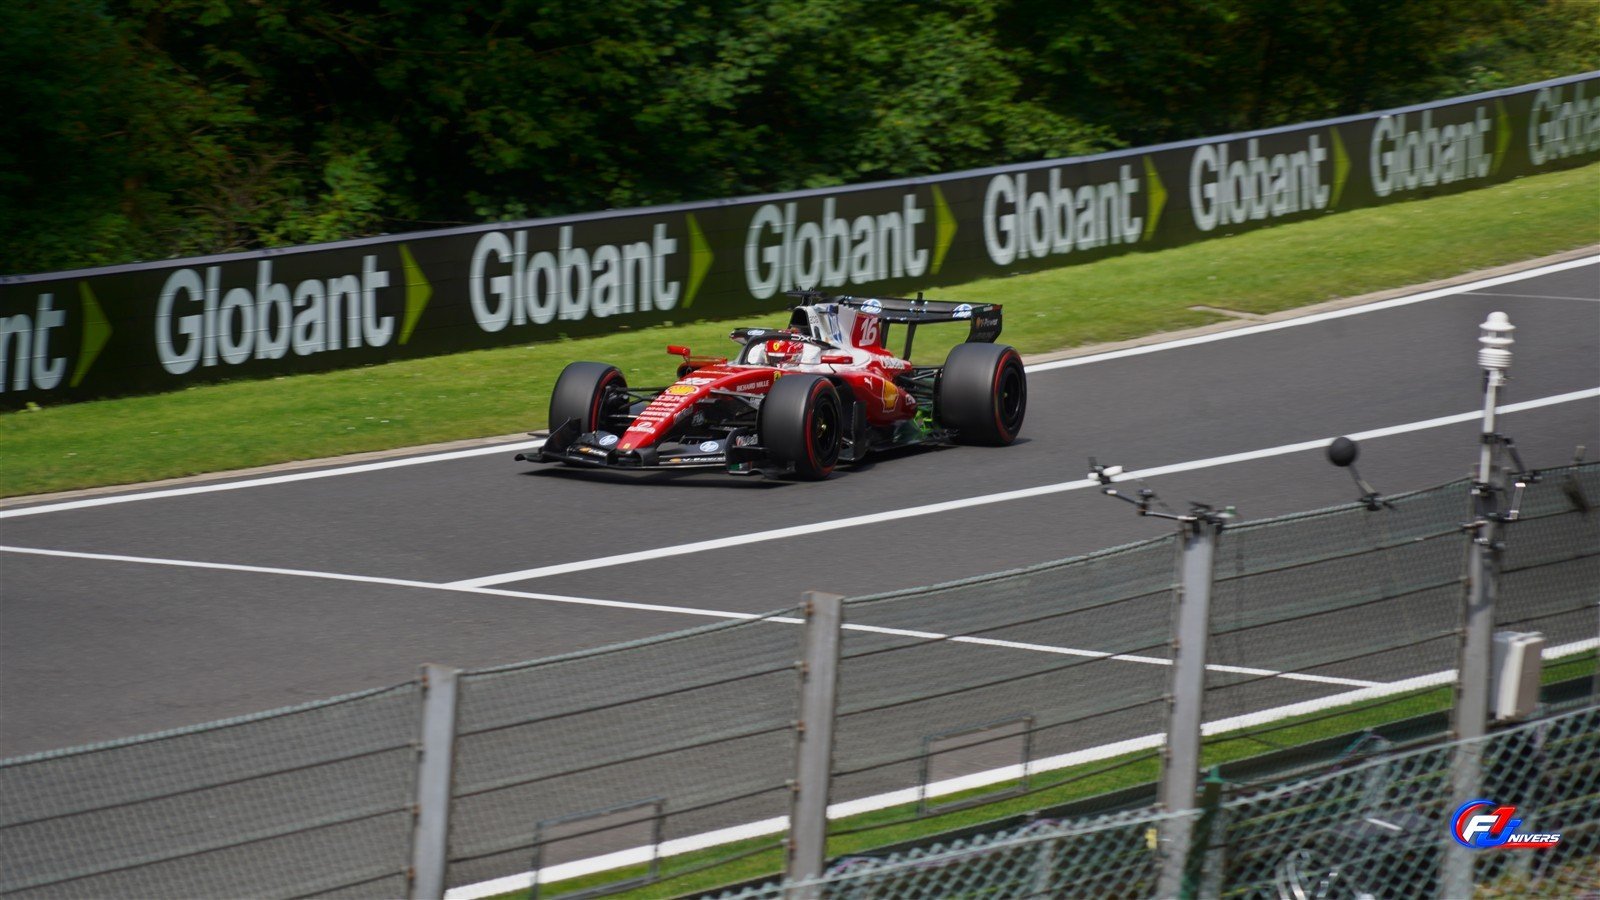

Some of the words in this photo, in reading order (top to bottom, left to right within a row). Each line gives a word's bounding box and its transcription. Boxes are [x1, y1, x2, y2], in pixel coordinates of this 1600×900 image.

[1189, 134, 1331, 231] Globant
[1370, 106, 1492, 197] Globant
[744, 193, 930, 299] Globant
[983, 164, 1143, 266] Globant
[155, 254, 395, 375] Globant
[469, 223, 681, 332] Globant
[858, 316, 879, 347] 16
[736, 382, 755, 392] RICHARD
[756, 380, 770, 389] MILLE
